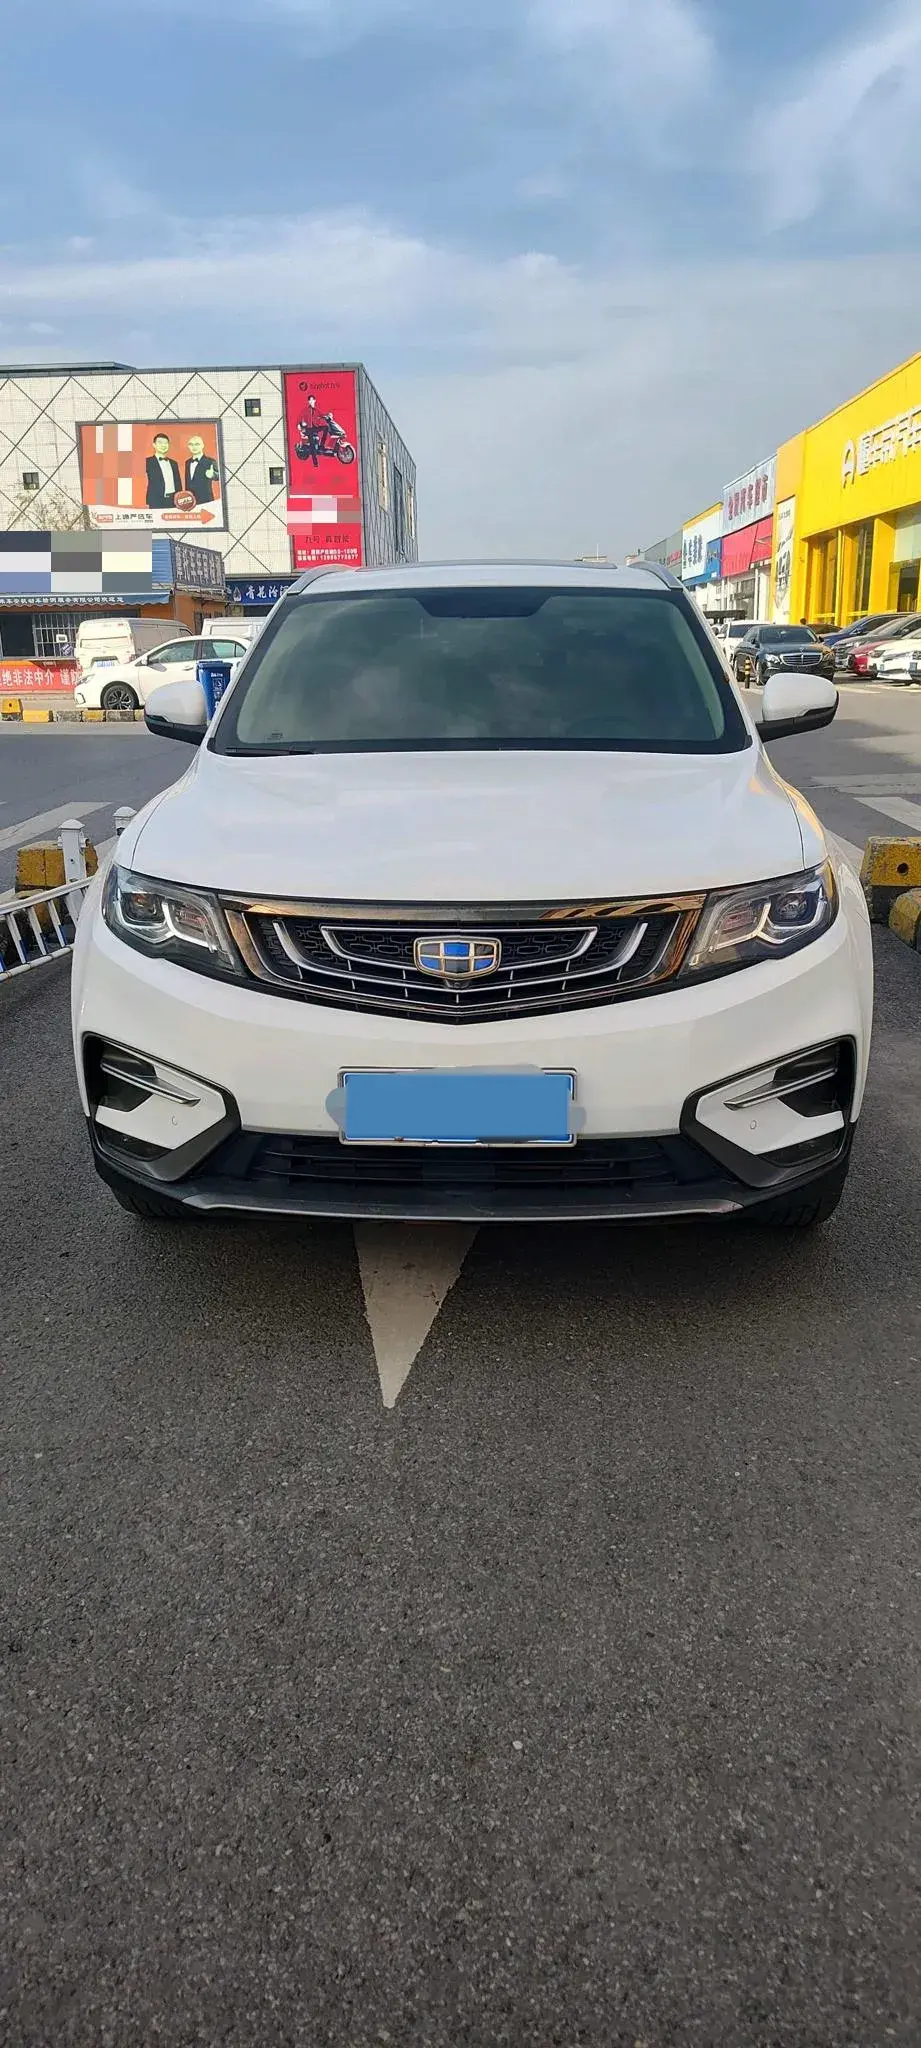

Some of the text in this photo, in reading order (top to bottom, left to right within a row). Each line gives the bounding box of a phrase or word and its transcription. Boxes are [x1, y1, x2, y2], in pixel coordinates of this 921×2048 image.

[0, 668, 54, 686] 绝非法中介
